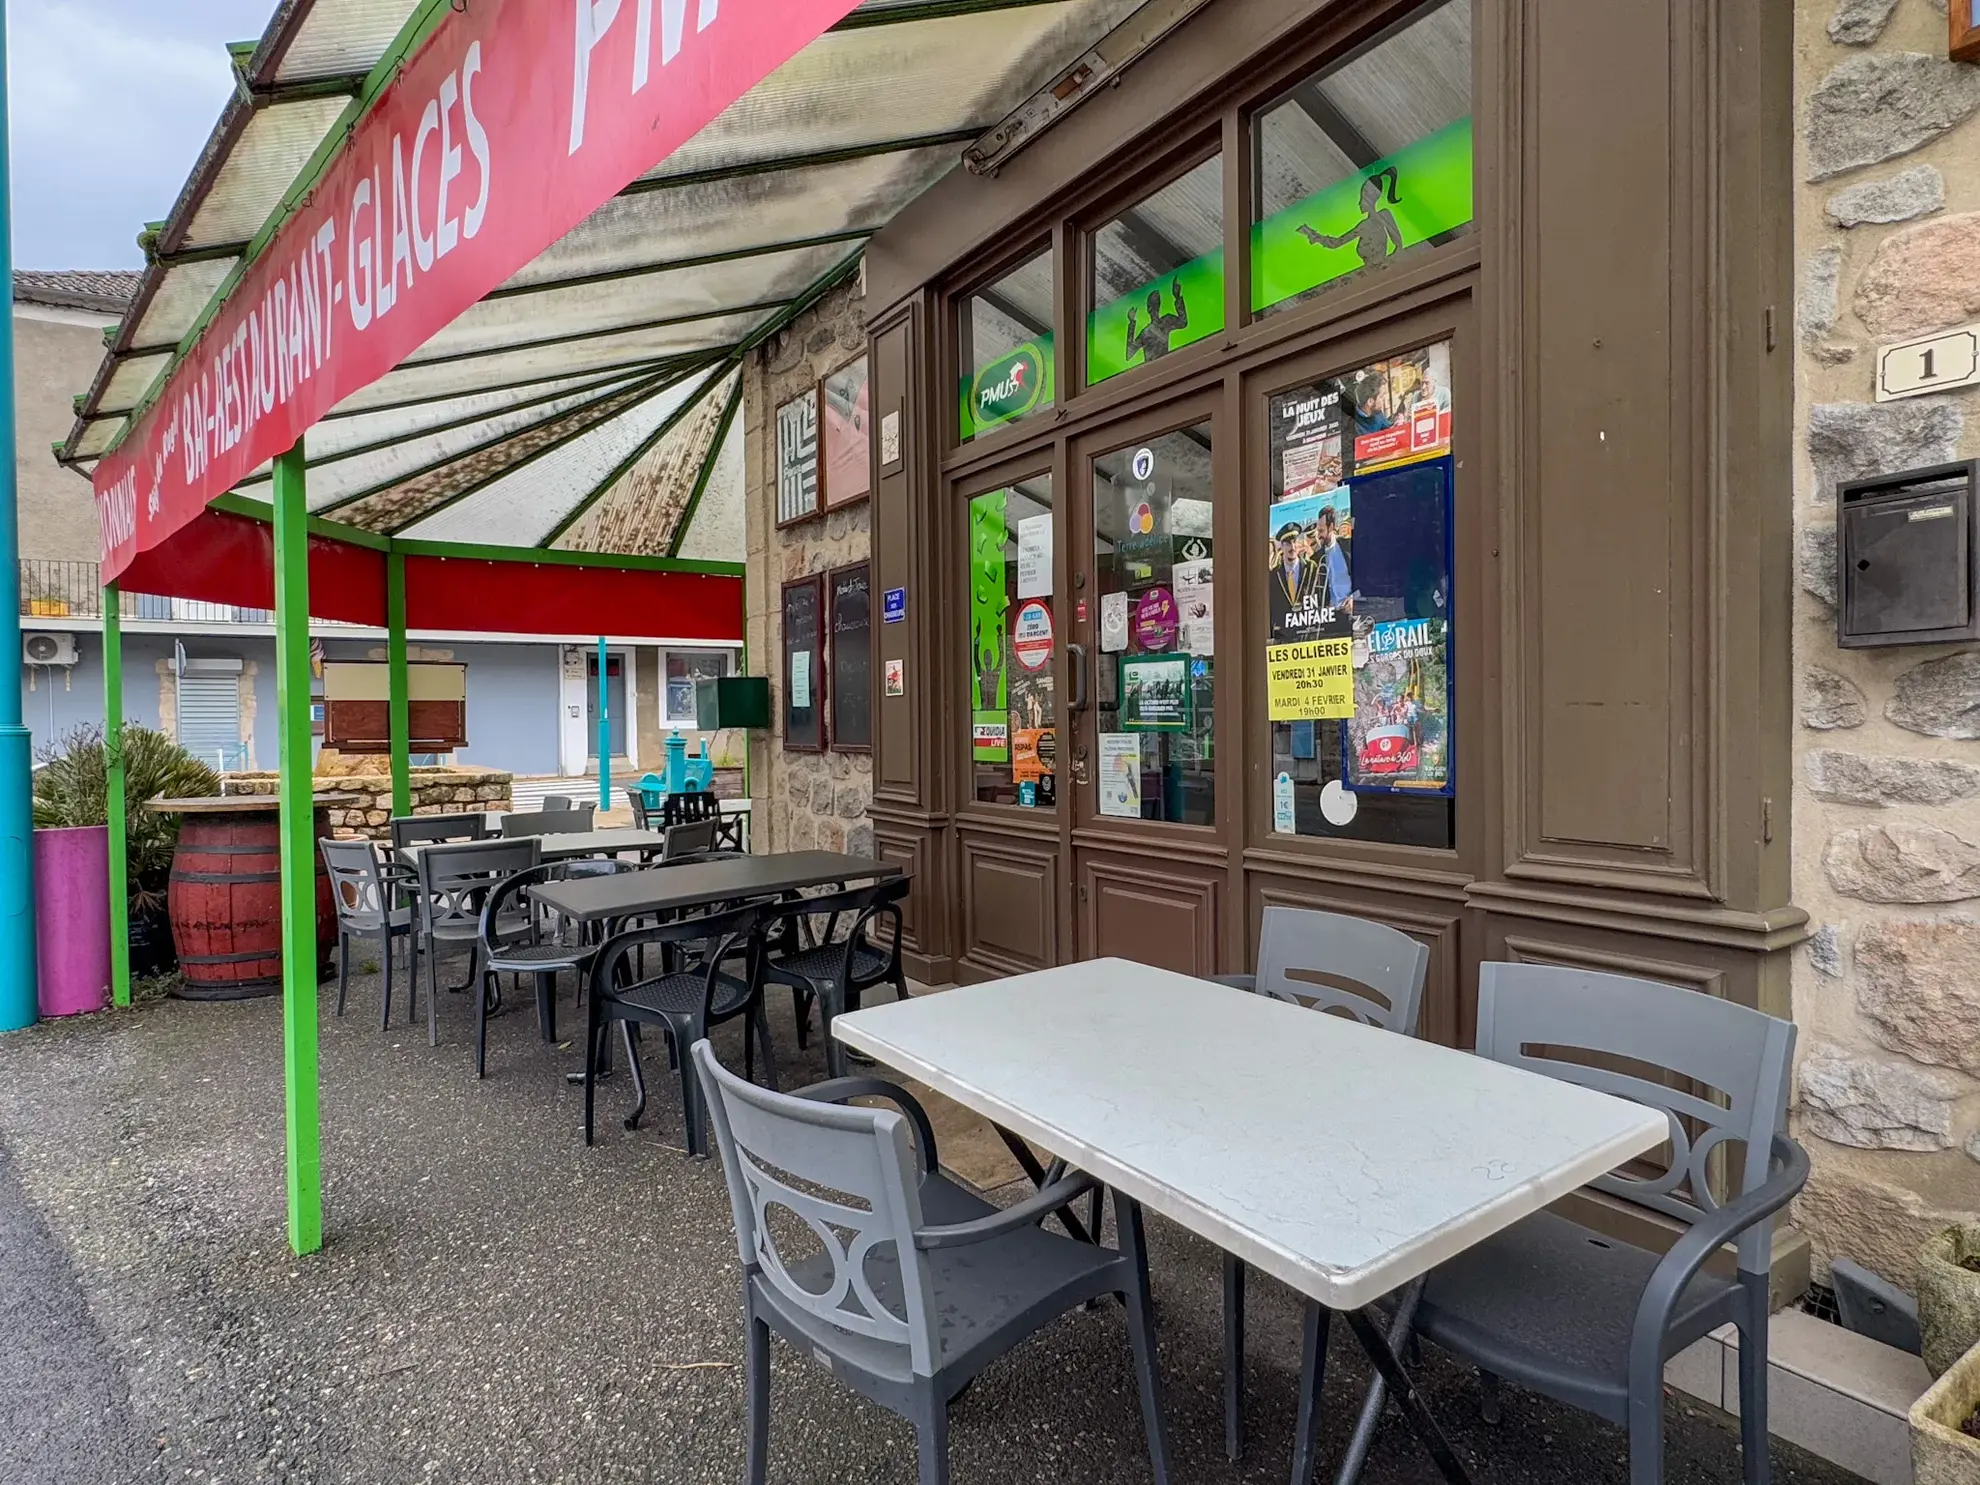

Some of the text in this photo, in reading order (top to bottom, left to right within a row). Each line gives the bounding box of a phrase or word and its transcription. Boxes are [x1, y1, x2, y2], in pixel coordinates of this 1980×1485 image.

[1918, 348, 1939, 380] 1
[980, 378, 1011, 409] PMU
[1282, 406, 1295, 418] LA
[1296, 398, 1320, 415] NUIT
[1321, 392, 1339, 407] DES
[1297, 407, 1326, 428] JEUX
[1302, 594, 1318, 611] EN
[1285, 607, 1337, 628] FANFARE
[1268, 649, 1289, 663] LES
[1403, 650, 1413, 660] DU
[1414, 646, 1433, 658] DOUX
[1272, 664, 1347, 681] VENDREDI 31 JANVIER
[1295, 679, 1324, 689] 20h30
[1274, 698, 1300, 708] MARDI
[1304, 696, 1309, 706] 4
[1298, 706, 1325, 716] 19h00
[990, 739, 1005, 747] LIVE
